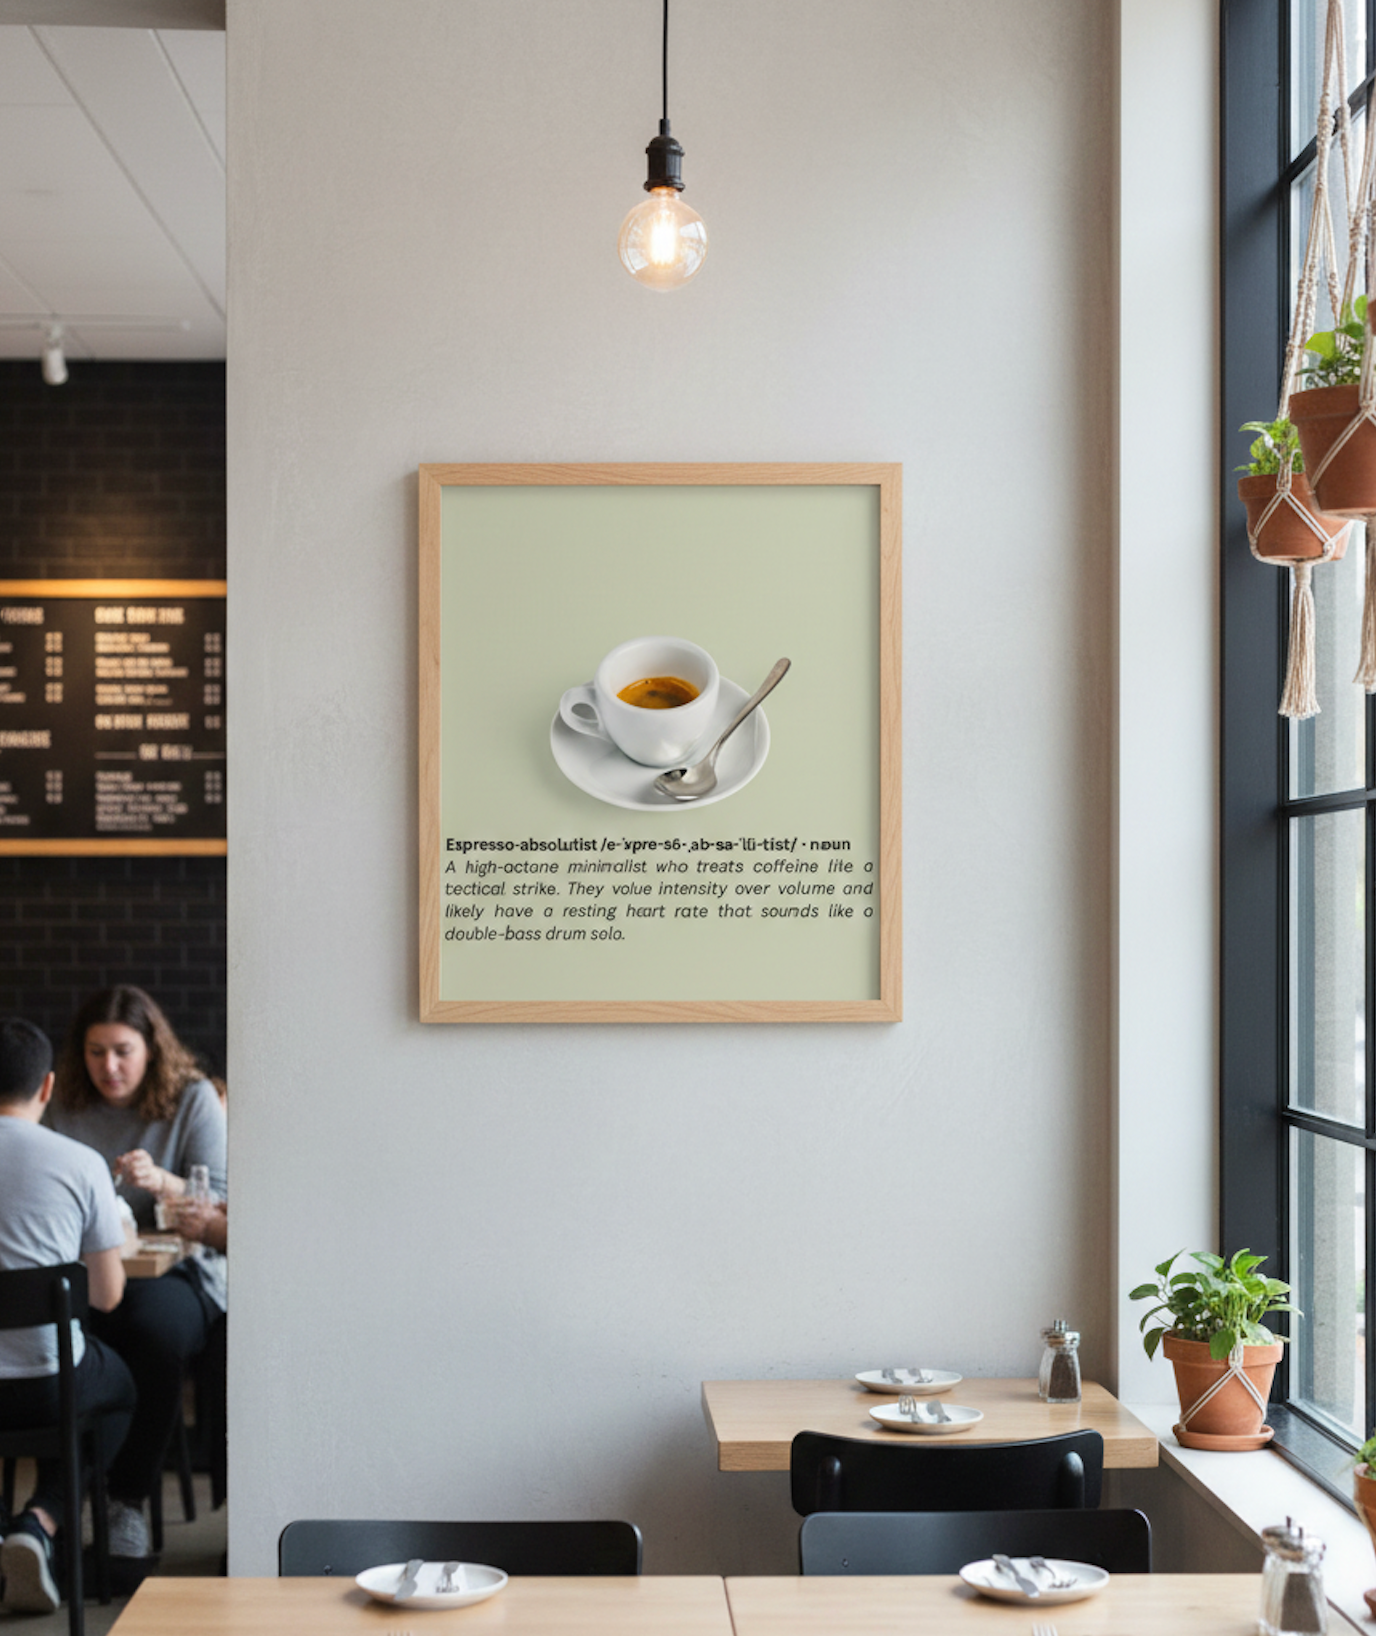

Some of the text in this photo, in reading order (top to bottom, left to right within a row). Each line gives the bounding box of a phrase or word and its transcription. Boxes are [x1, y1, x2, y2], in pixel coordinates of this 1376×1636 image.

[445, 860, 456, 873] A
[656, 860, 688, 873] who
[697, 860, 743, 873] treats
[513, 882, 560, 895] strike.
[568, 881, 604, 898] They
[658, 881, 728, 899] intensity
[735, 884, 771, 895] over
[778, 881, 835, 895] volume
[843, 881, 874, 895] and
[445, 904, 484, 921] likely
[494, 904, 533, 918] have
[562, 904, 617, 921] resting
[674, 905, 709, 918] rate
[718, 904, 753, 918] that
[761, 904, 819, 918] sounds
[829, 904, 854, 918] like
[445, 925, 541, 941] double-bass
[546, 926, 586, 941] drum
